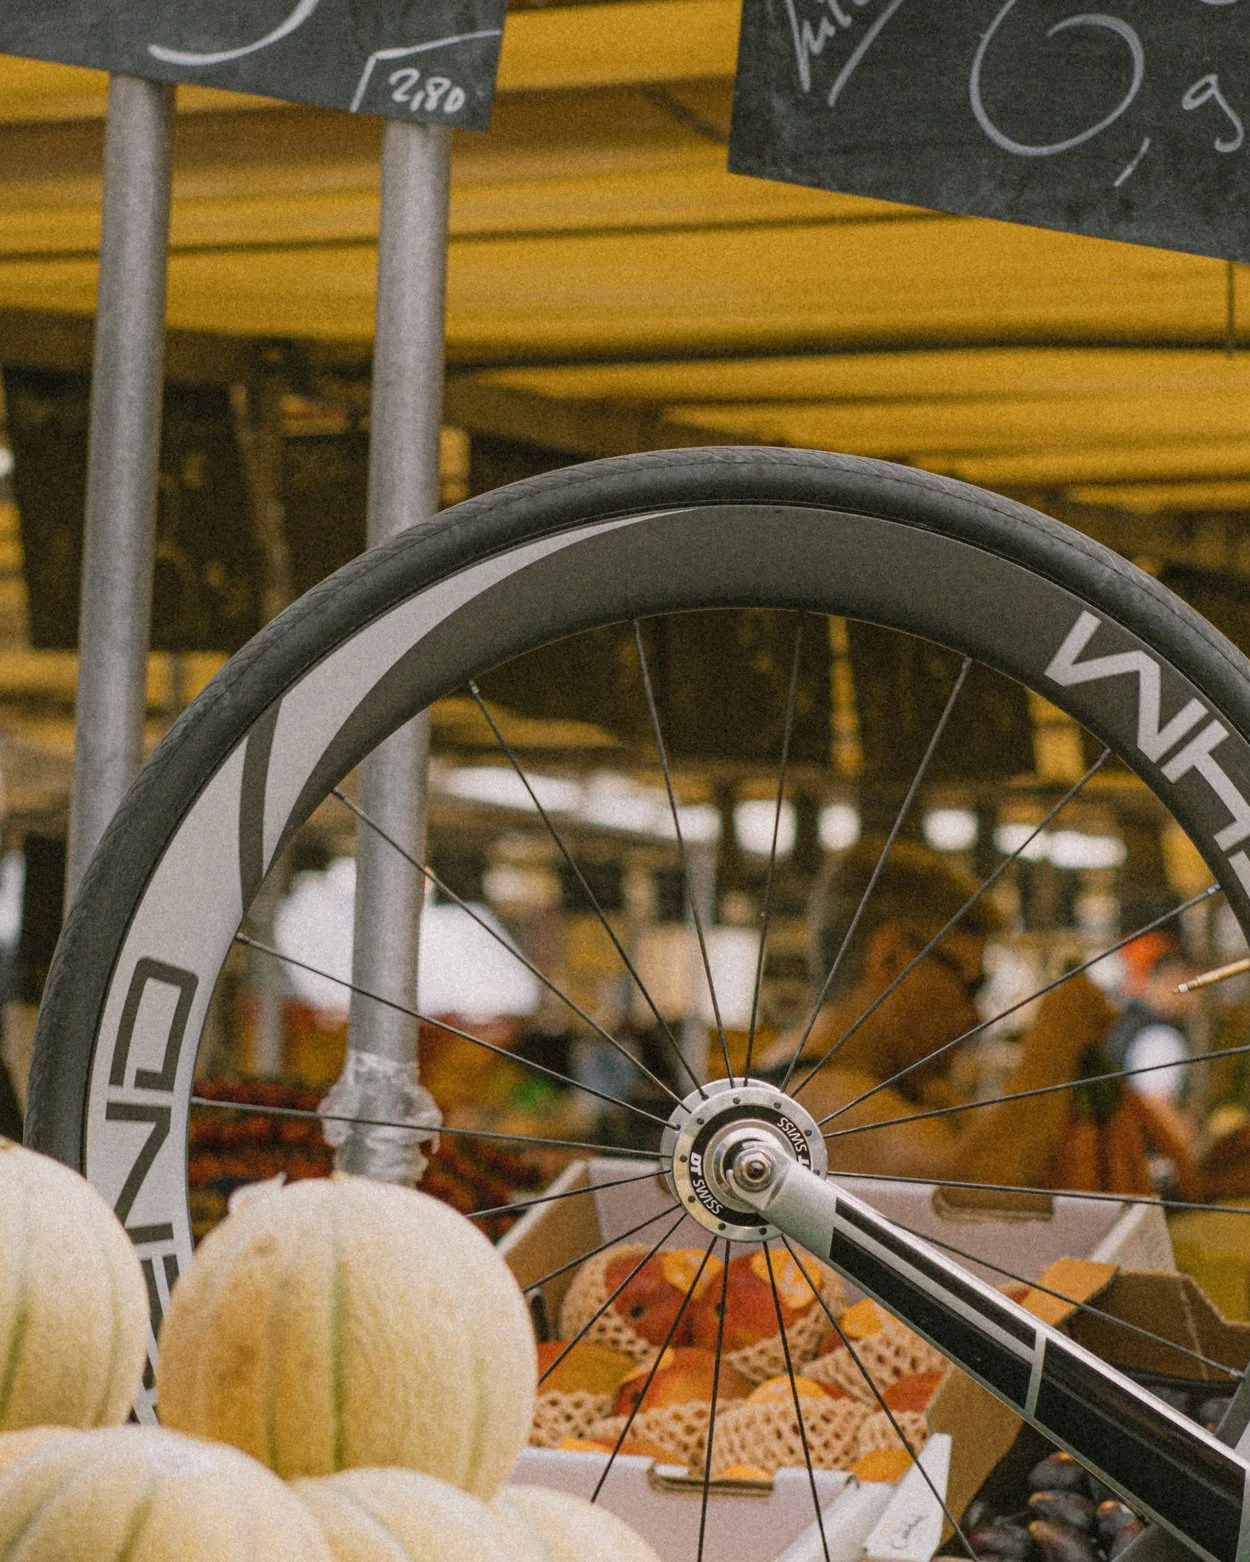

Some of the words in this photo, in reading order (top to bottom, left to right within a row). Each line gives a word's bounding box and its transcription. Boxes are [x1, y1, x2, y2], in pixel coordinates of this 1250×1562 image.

[776, 1117, 807, 1153] SWISS
[691, 1152, 702, 1177] DT
[693, 1178, 724, 1215] SWISS
